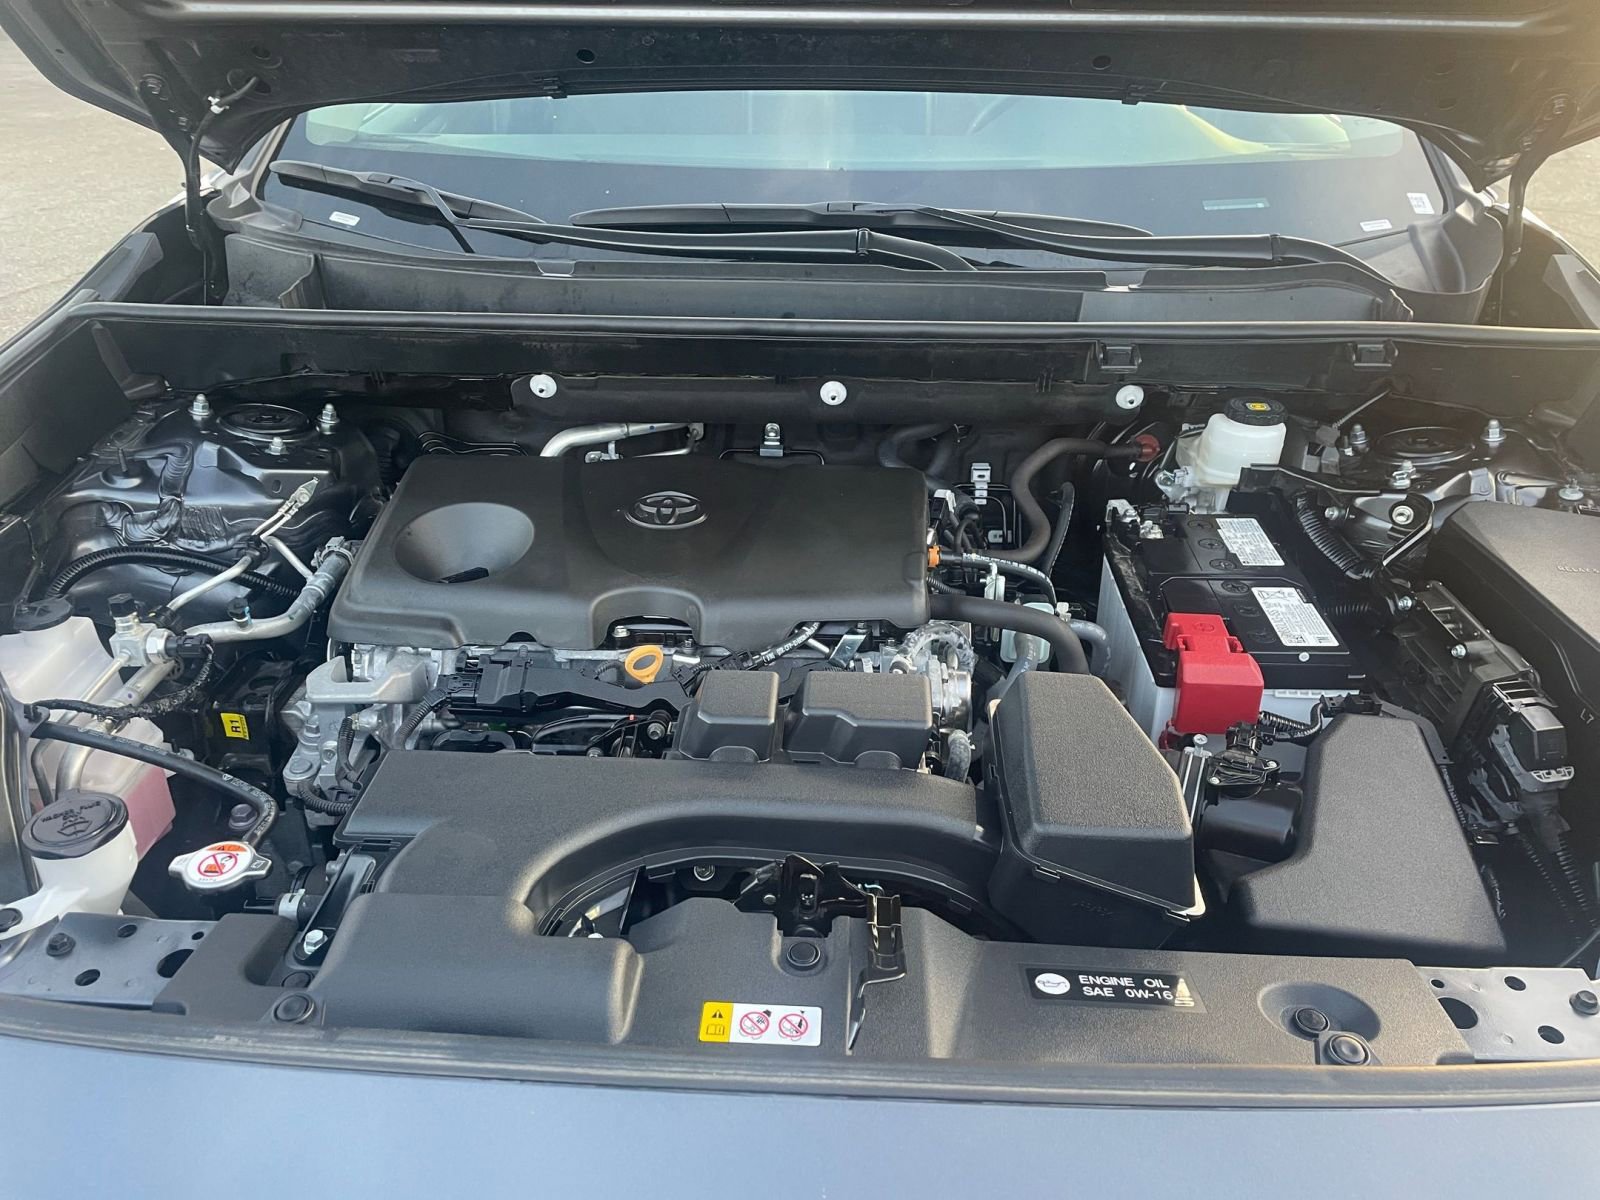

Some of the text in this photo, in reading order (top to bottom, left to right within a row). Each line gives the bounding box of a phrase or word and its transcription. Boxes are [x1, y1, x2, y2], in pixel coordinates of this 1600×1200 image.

[1079, 975, 1170, 988] ENGINE OIL
[1083, 987, 1173, 1000] SAE 0W-16
